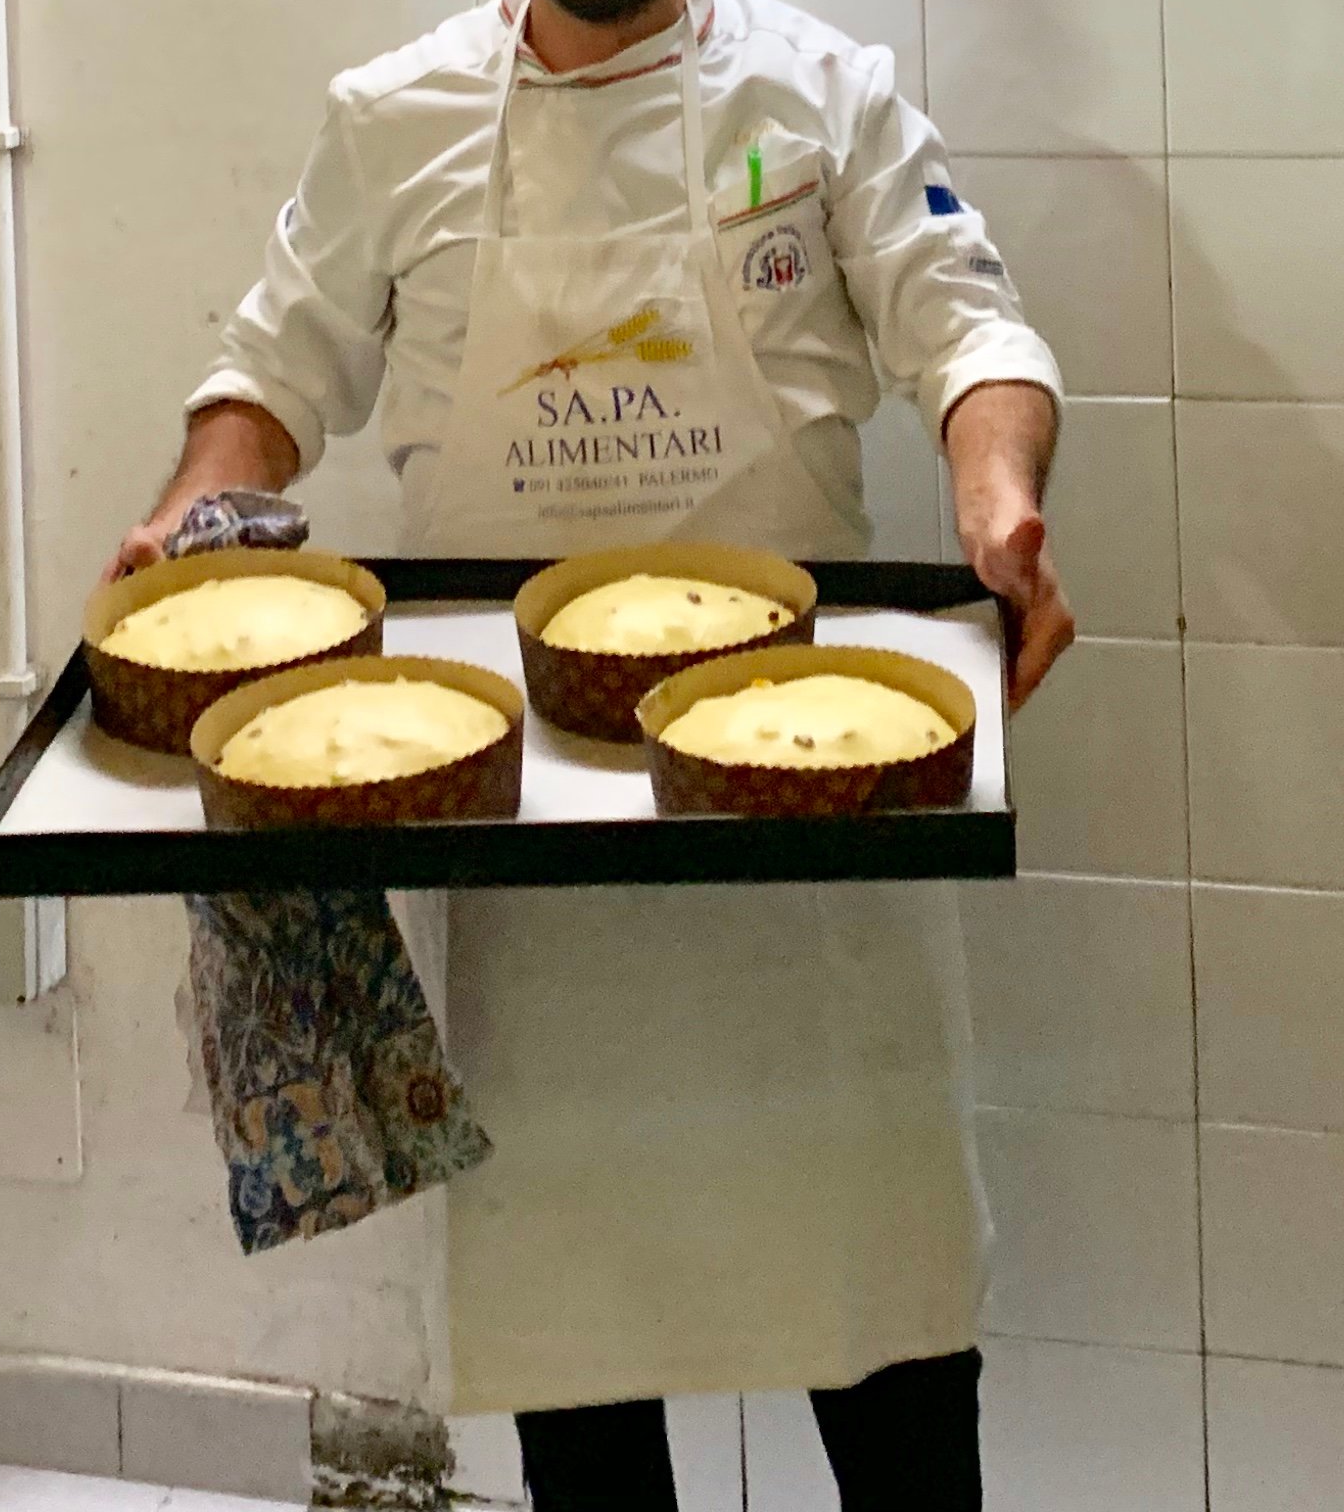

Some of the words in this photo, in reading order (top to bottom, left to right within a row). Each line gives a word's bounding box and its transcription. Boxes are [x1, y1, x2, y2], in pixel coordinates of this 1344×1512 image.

[537, 384, 682, 428] SA.PA.
[505, 425, 723, 468] ALIMENTARI
[639, 467, 719, 488] PALERMO
